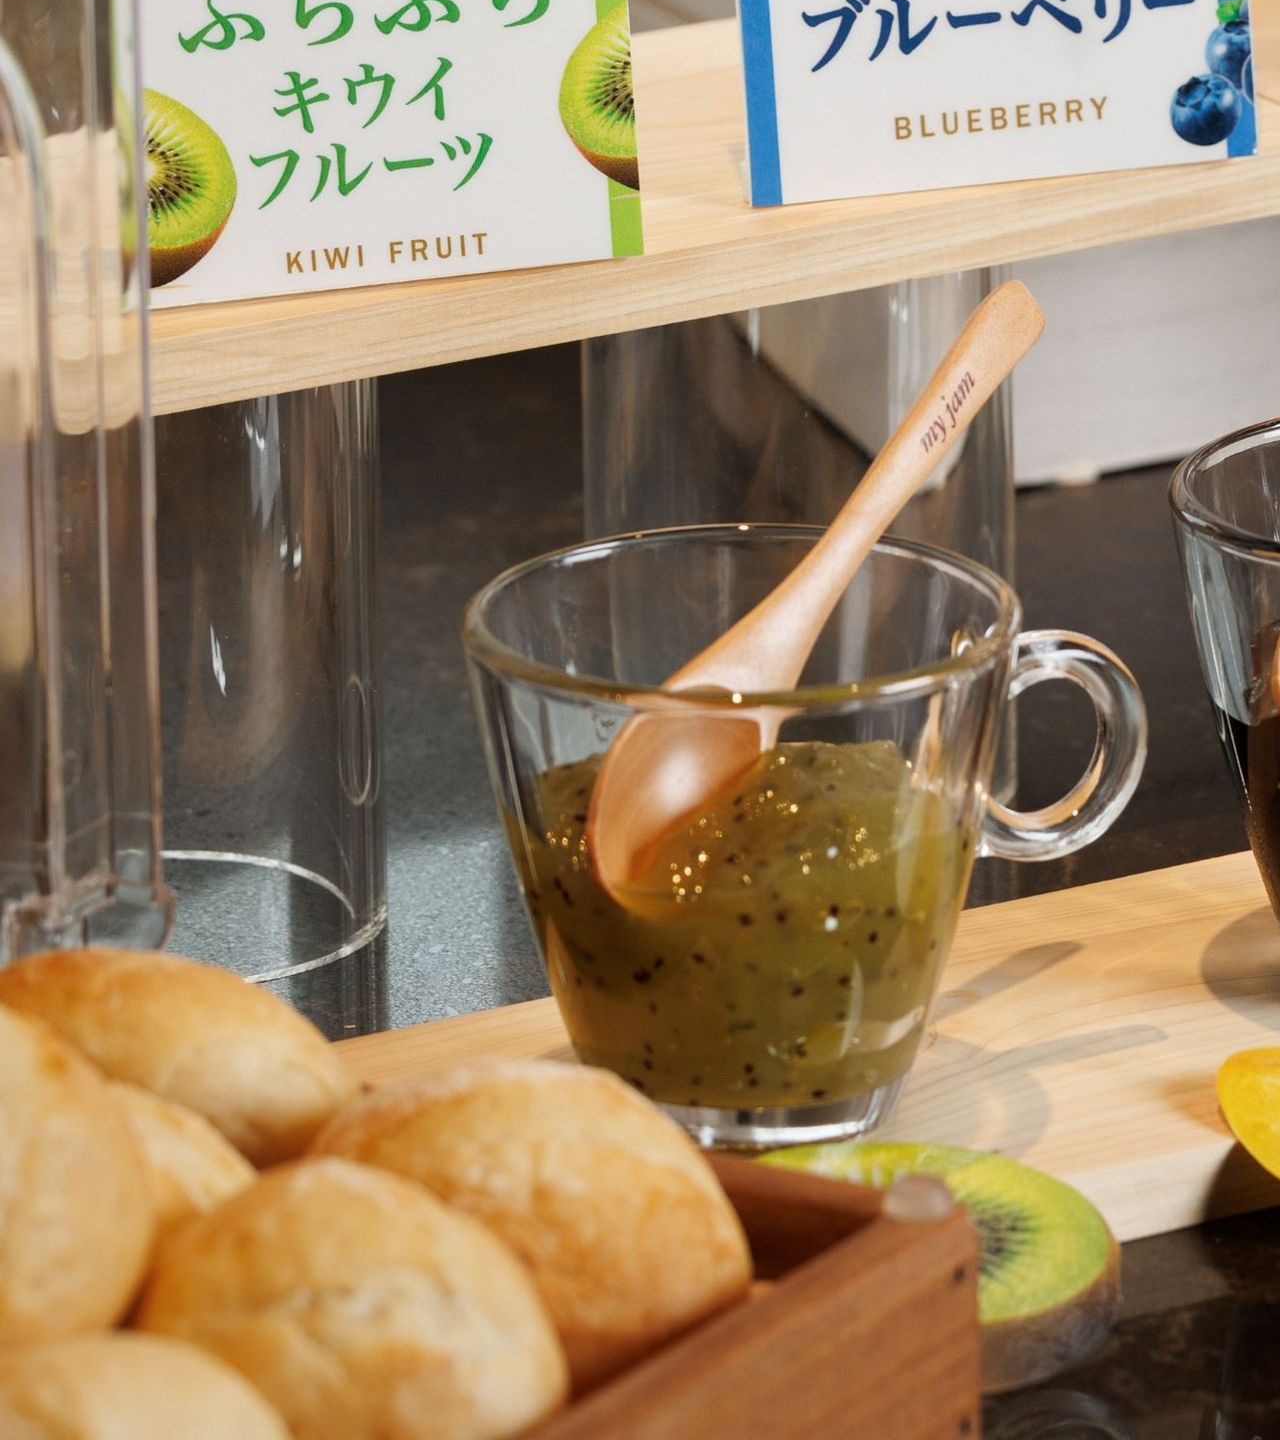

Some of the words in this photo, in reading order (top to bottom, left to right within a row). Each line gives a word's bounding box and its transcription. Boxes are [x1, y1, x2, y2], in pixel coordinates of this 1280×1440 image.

[271, 56, 455, 134] キウイ
[893, 96, 1109, 141] BLUEBERRY
[248, 132, 494, 211] フルーツ
[286, 244, 365, 275] KIWI
[388, 231, 488, 264] FRUIT
[920, 414, 948, 454] my
[940, 370, 976, 429] jam
